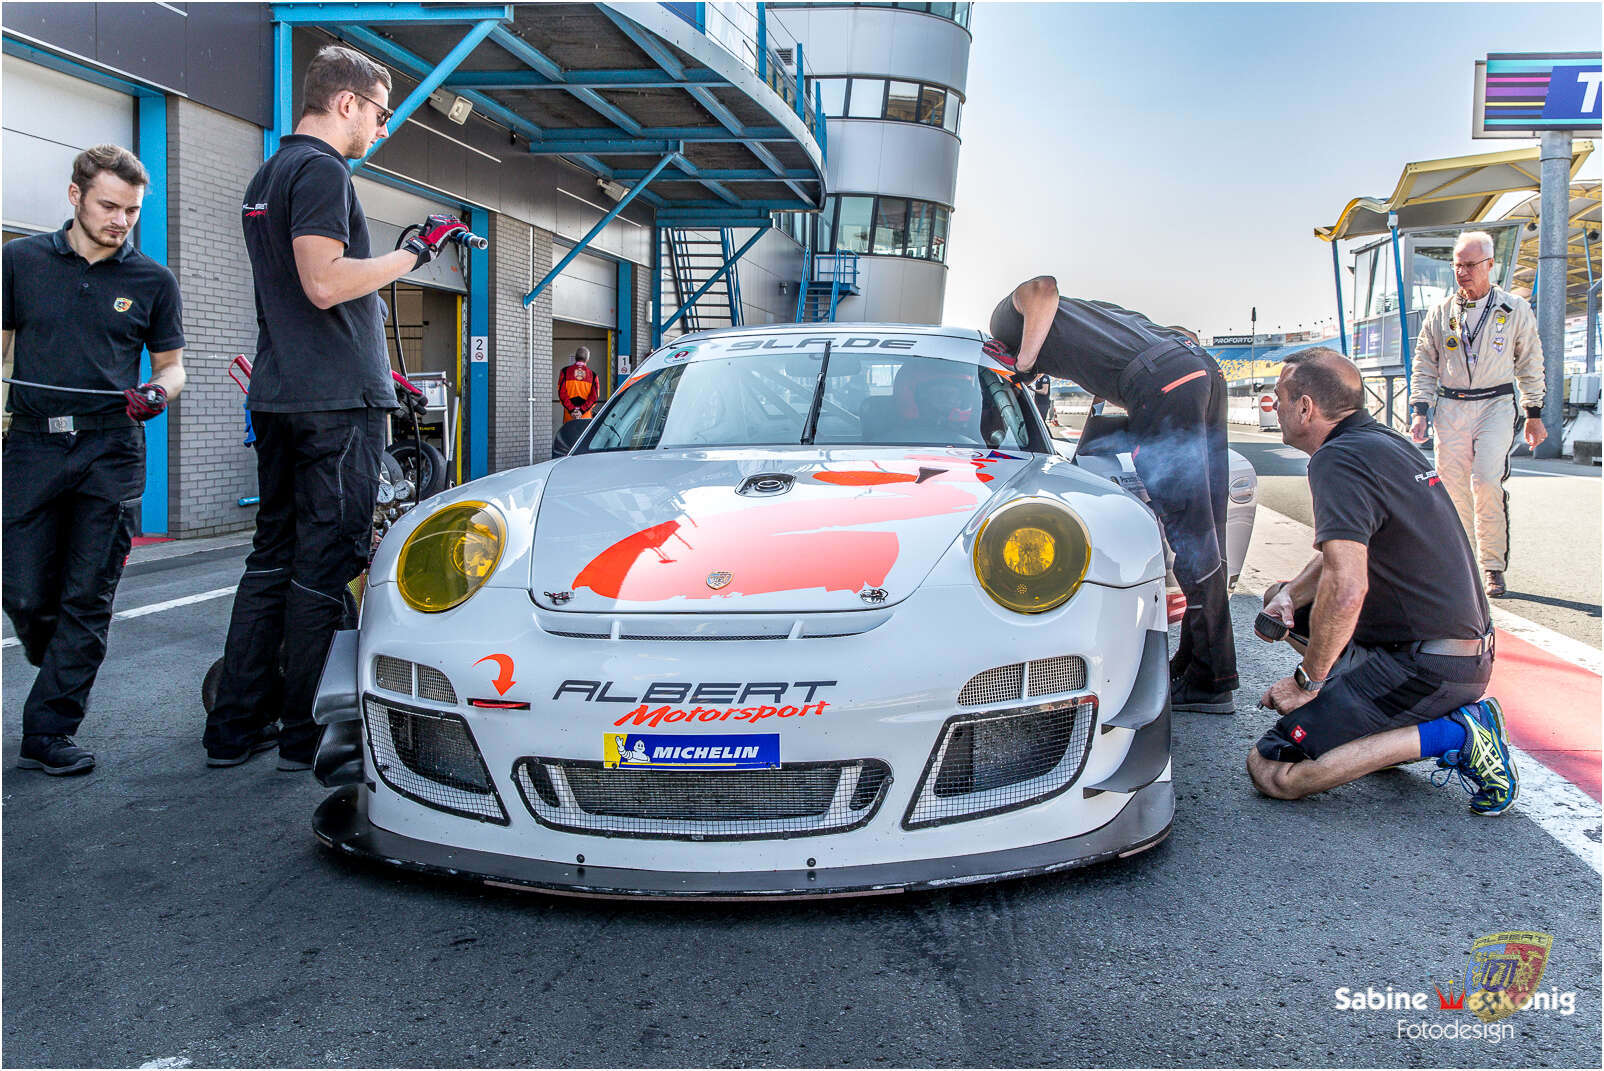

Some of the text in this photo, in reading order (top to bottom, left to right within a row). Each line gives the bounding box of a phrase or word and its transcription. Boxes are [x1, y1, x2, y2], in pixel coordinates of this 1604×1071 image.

[475, 338, 484, 351] 2
[551, 679, 838, 705] ALBERT
[613, 700, 831, 728] Motorsport
[652, 745, 760, 760] MICHELIN
